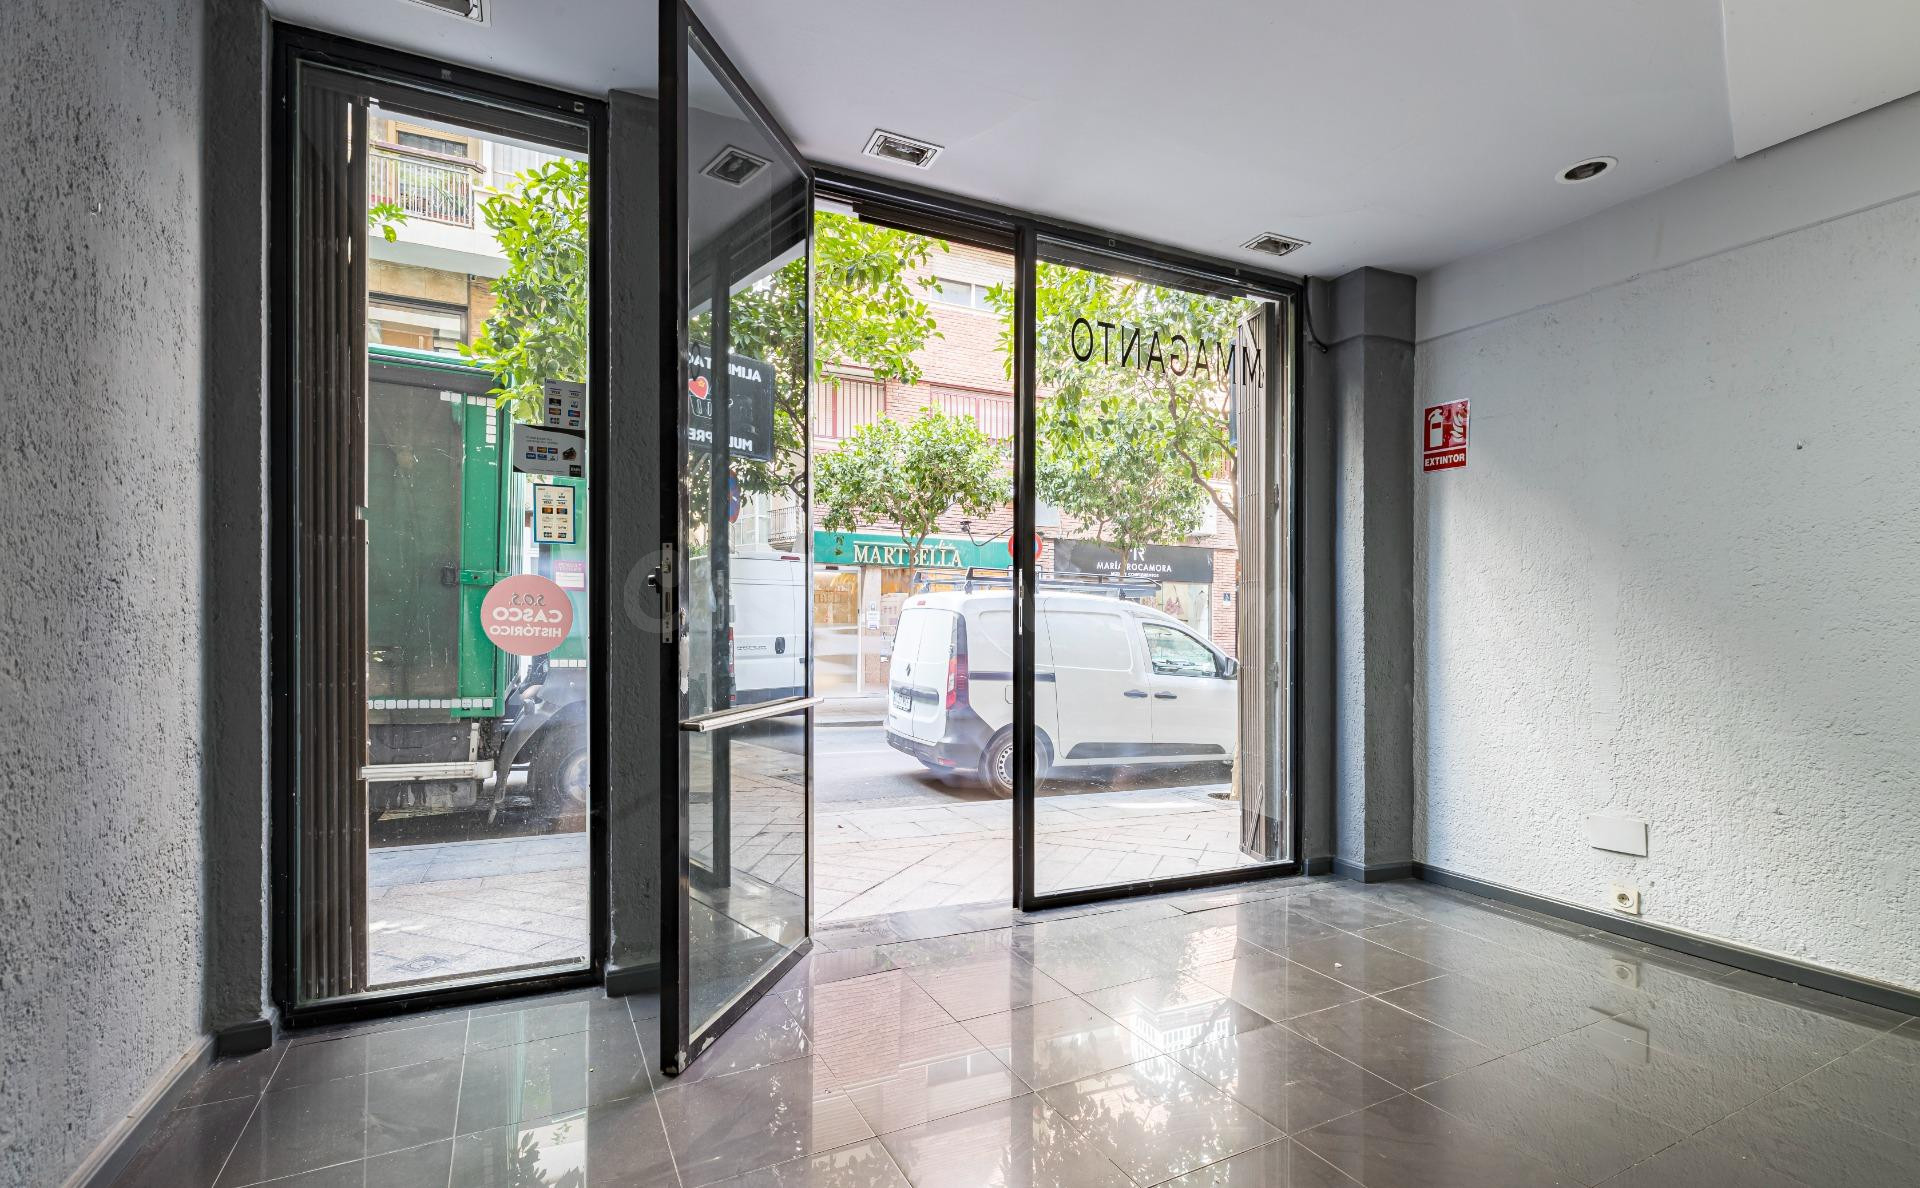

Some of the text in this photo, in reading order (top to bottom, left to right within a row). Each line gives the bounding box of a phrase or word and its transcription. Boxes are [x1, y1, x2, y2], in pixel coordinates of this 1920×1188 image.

[1424, 453, 1465, 467] EXTINTOR
[852, 544, 962, 568] MARTBELLA
[1126, 563, 1172, 573] ROCAMORA
